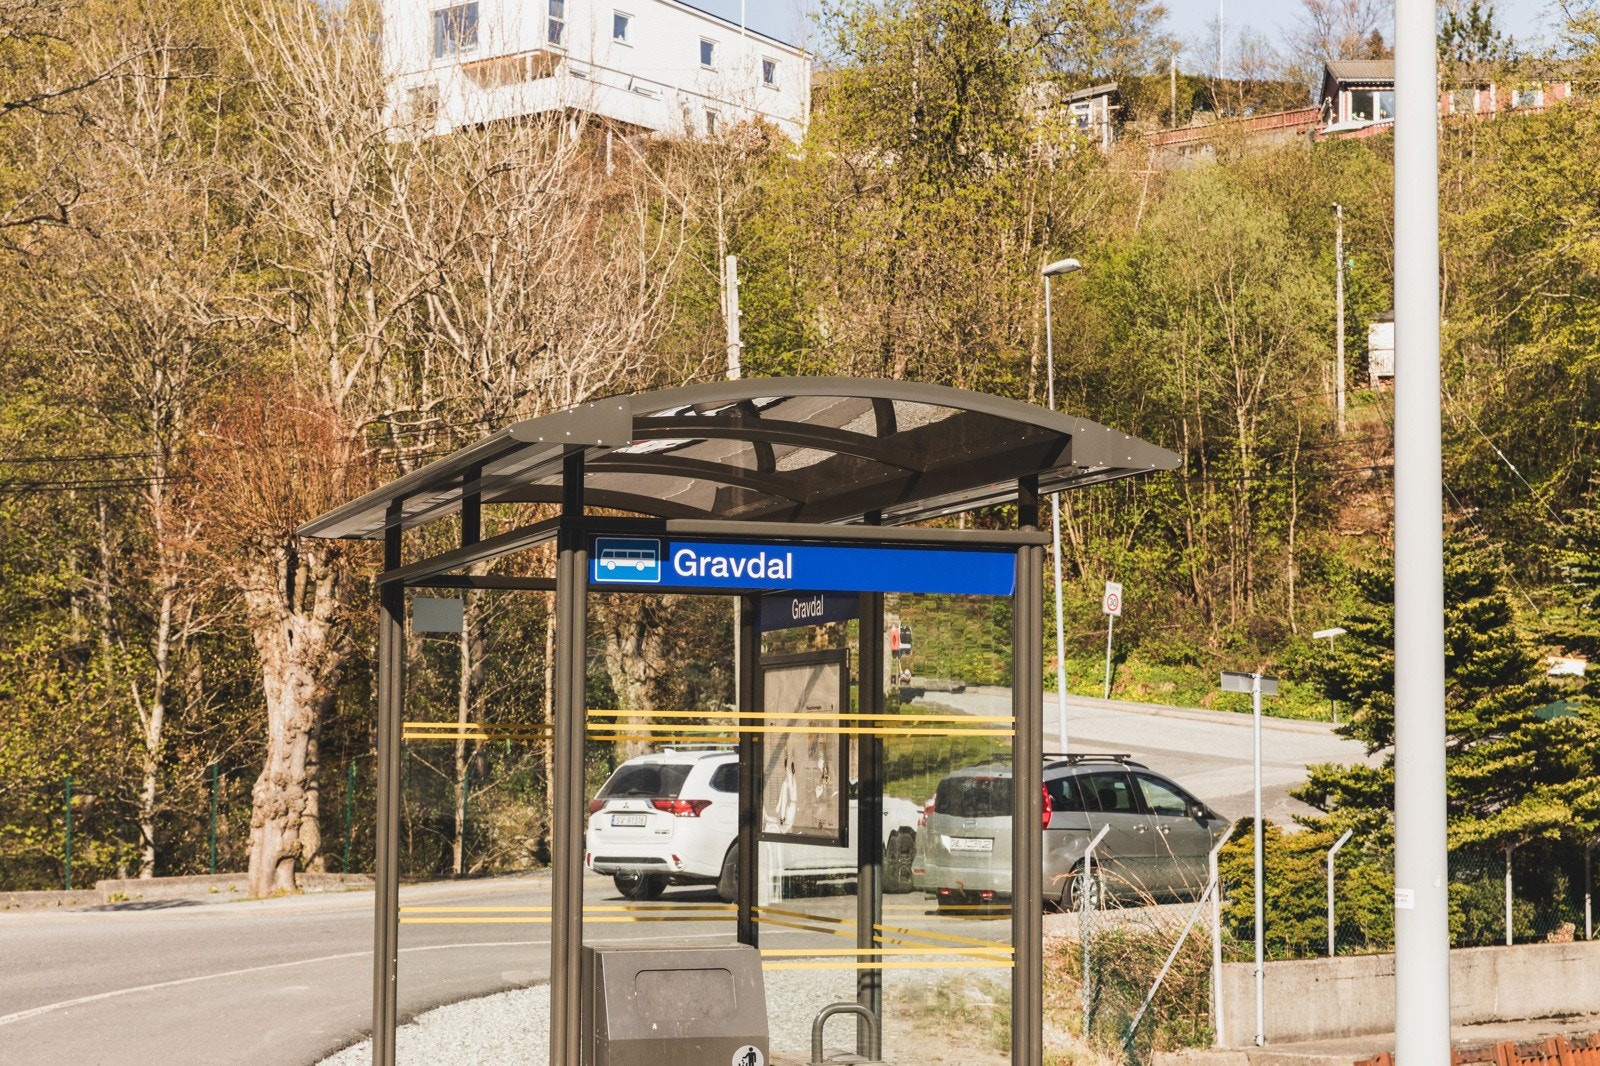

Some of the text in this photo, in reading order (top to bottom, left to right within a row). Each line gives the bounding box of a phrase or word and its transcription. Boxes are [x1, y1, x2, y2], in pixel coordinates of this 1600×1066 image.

[673, 548, 792, 579] Gravdal
[792, 594, 824, 620] Gravdal
[1109, 597, 1116, 607] 30
